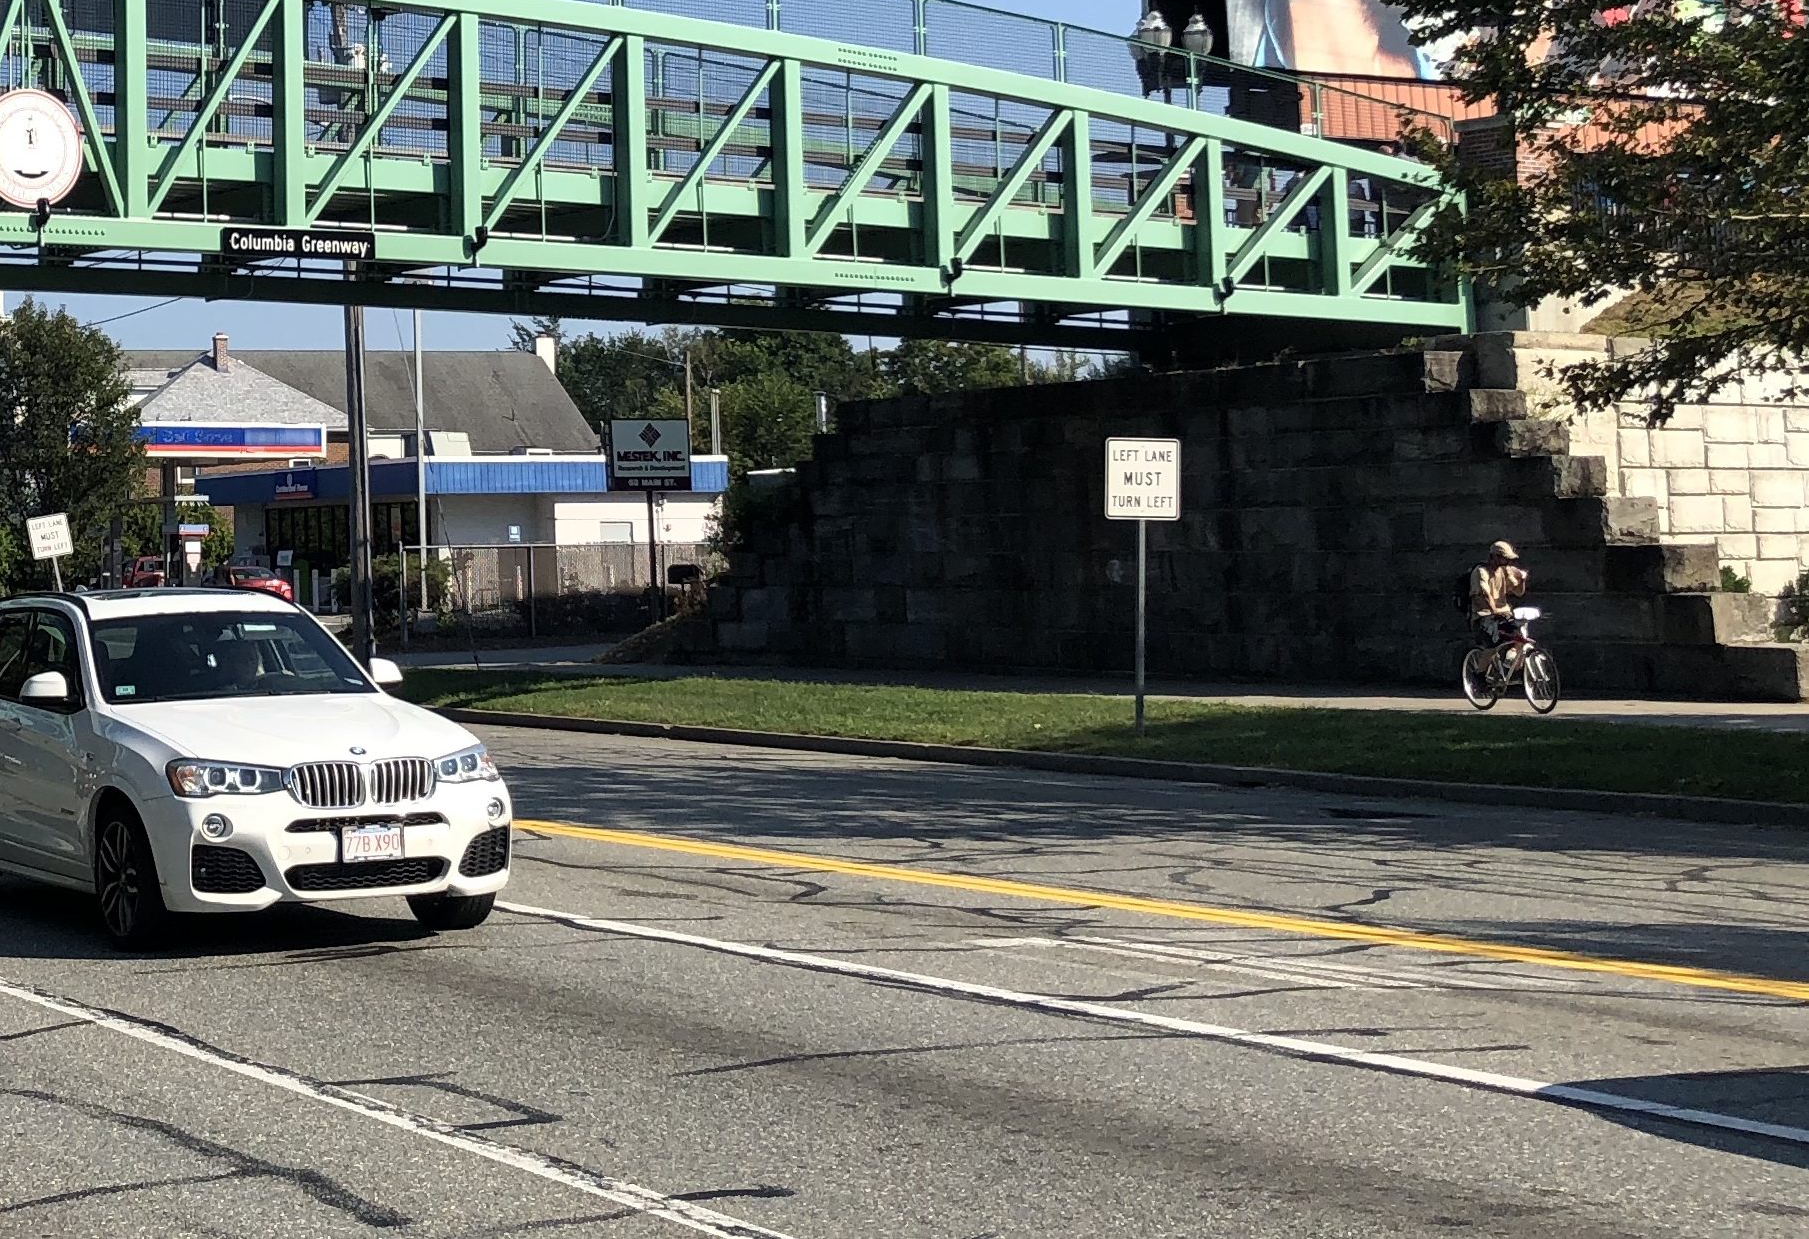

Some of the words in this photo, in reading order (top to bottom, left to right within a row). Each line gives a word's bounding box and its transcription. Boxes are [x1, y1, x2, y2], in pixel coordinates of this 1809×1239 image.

[230, 232, 295, 252] Columbia
[302, 235, 368, 258] Greenway
[663, 450, 685, 462] INC.
[1112, 449, 1139, 462] LEFT
[1144, 450, 1173, 463] LANE
[1123, 471, 1162, 486] MUST
[1112, 495, 1141, 508] TURN
[1146, 496, 1173, 509] LEFT
[32, 522, 45, 530] LEFT
[48, 519, 63, 527] LANE
[40, 531, 59, 541] MUST
[345, 835, 371, 854] 77B
[375, 833, 400, 852] X90
